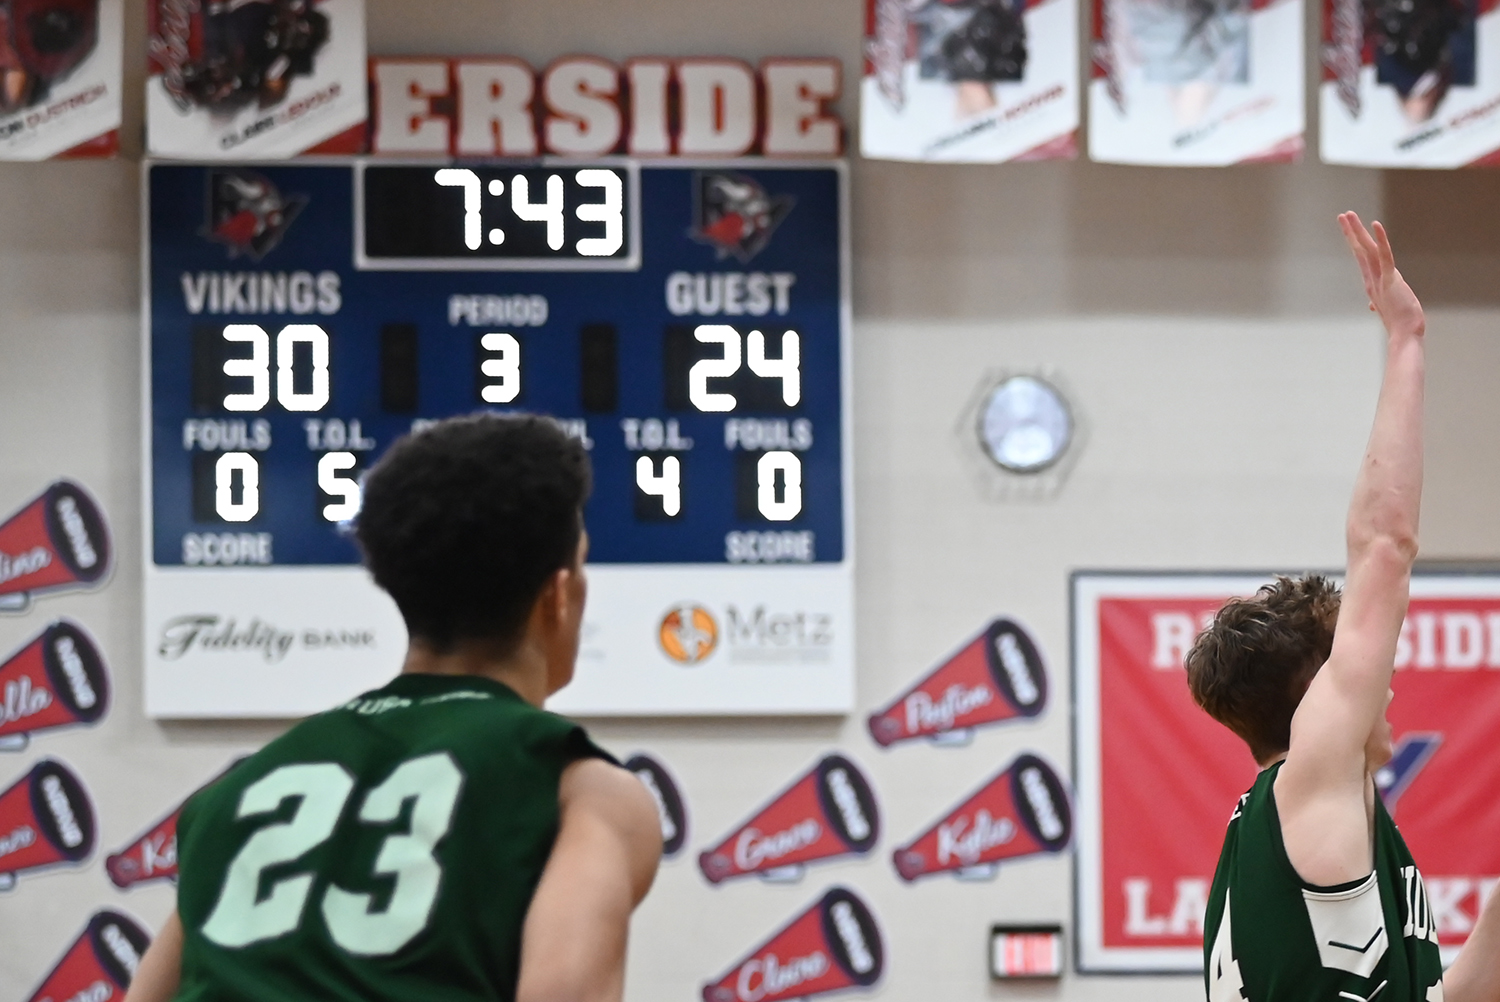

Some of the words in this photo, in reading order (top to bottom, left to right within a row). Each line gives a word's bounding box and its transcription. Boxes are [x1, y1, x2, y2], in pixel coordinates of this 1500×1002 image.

[373, 58, 841, 155] ERSIDE
[434, 169, 622, 255] 7:43
[181, 271, 342, 315] VIKINGS
[449, 295, 548, 327] PERIOD
[666, 272, 796, 316] GUEST
[223, 324, 329, 411] 30
[481, 333, 520, 403] 3
[690, 325, 800, 412] 24
[183, 419, 272, 450] FOULS
[724, 418, 813, 450] FOULS
[216, 452, 258, 521] 0
[318, 452, 361, 521] 5
[636, 456, 680, 516] 4
[758, 451, 801, 521] 0
[182, 533, 272, 564] SCORE
[725, 530, 814, 563] SCORE
[156, 613, 295, 664] Fidelity
[301, 627, 376, 649] BANK
[726, 603, 834, 646] Metz
[201, 751, 467, 957] 23
